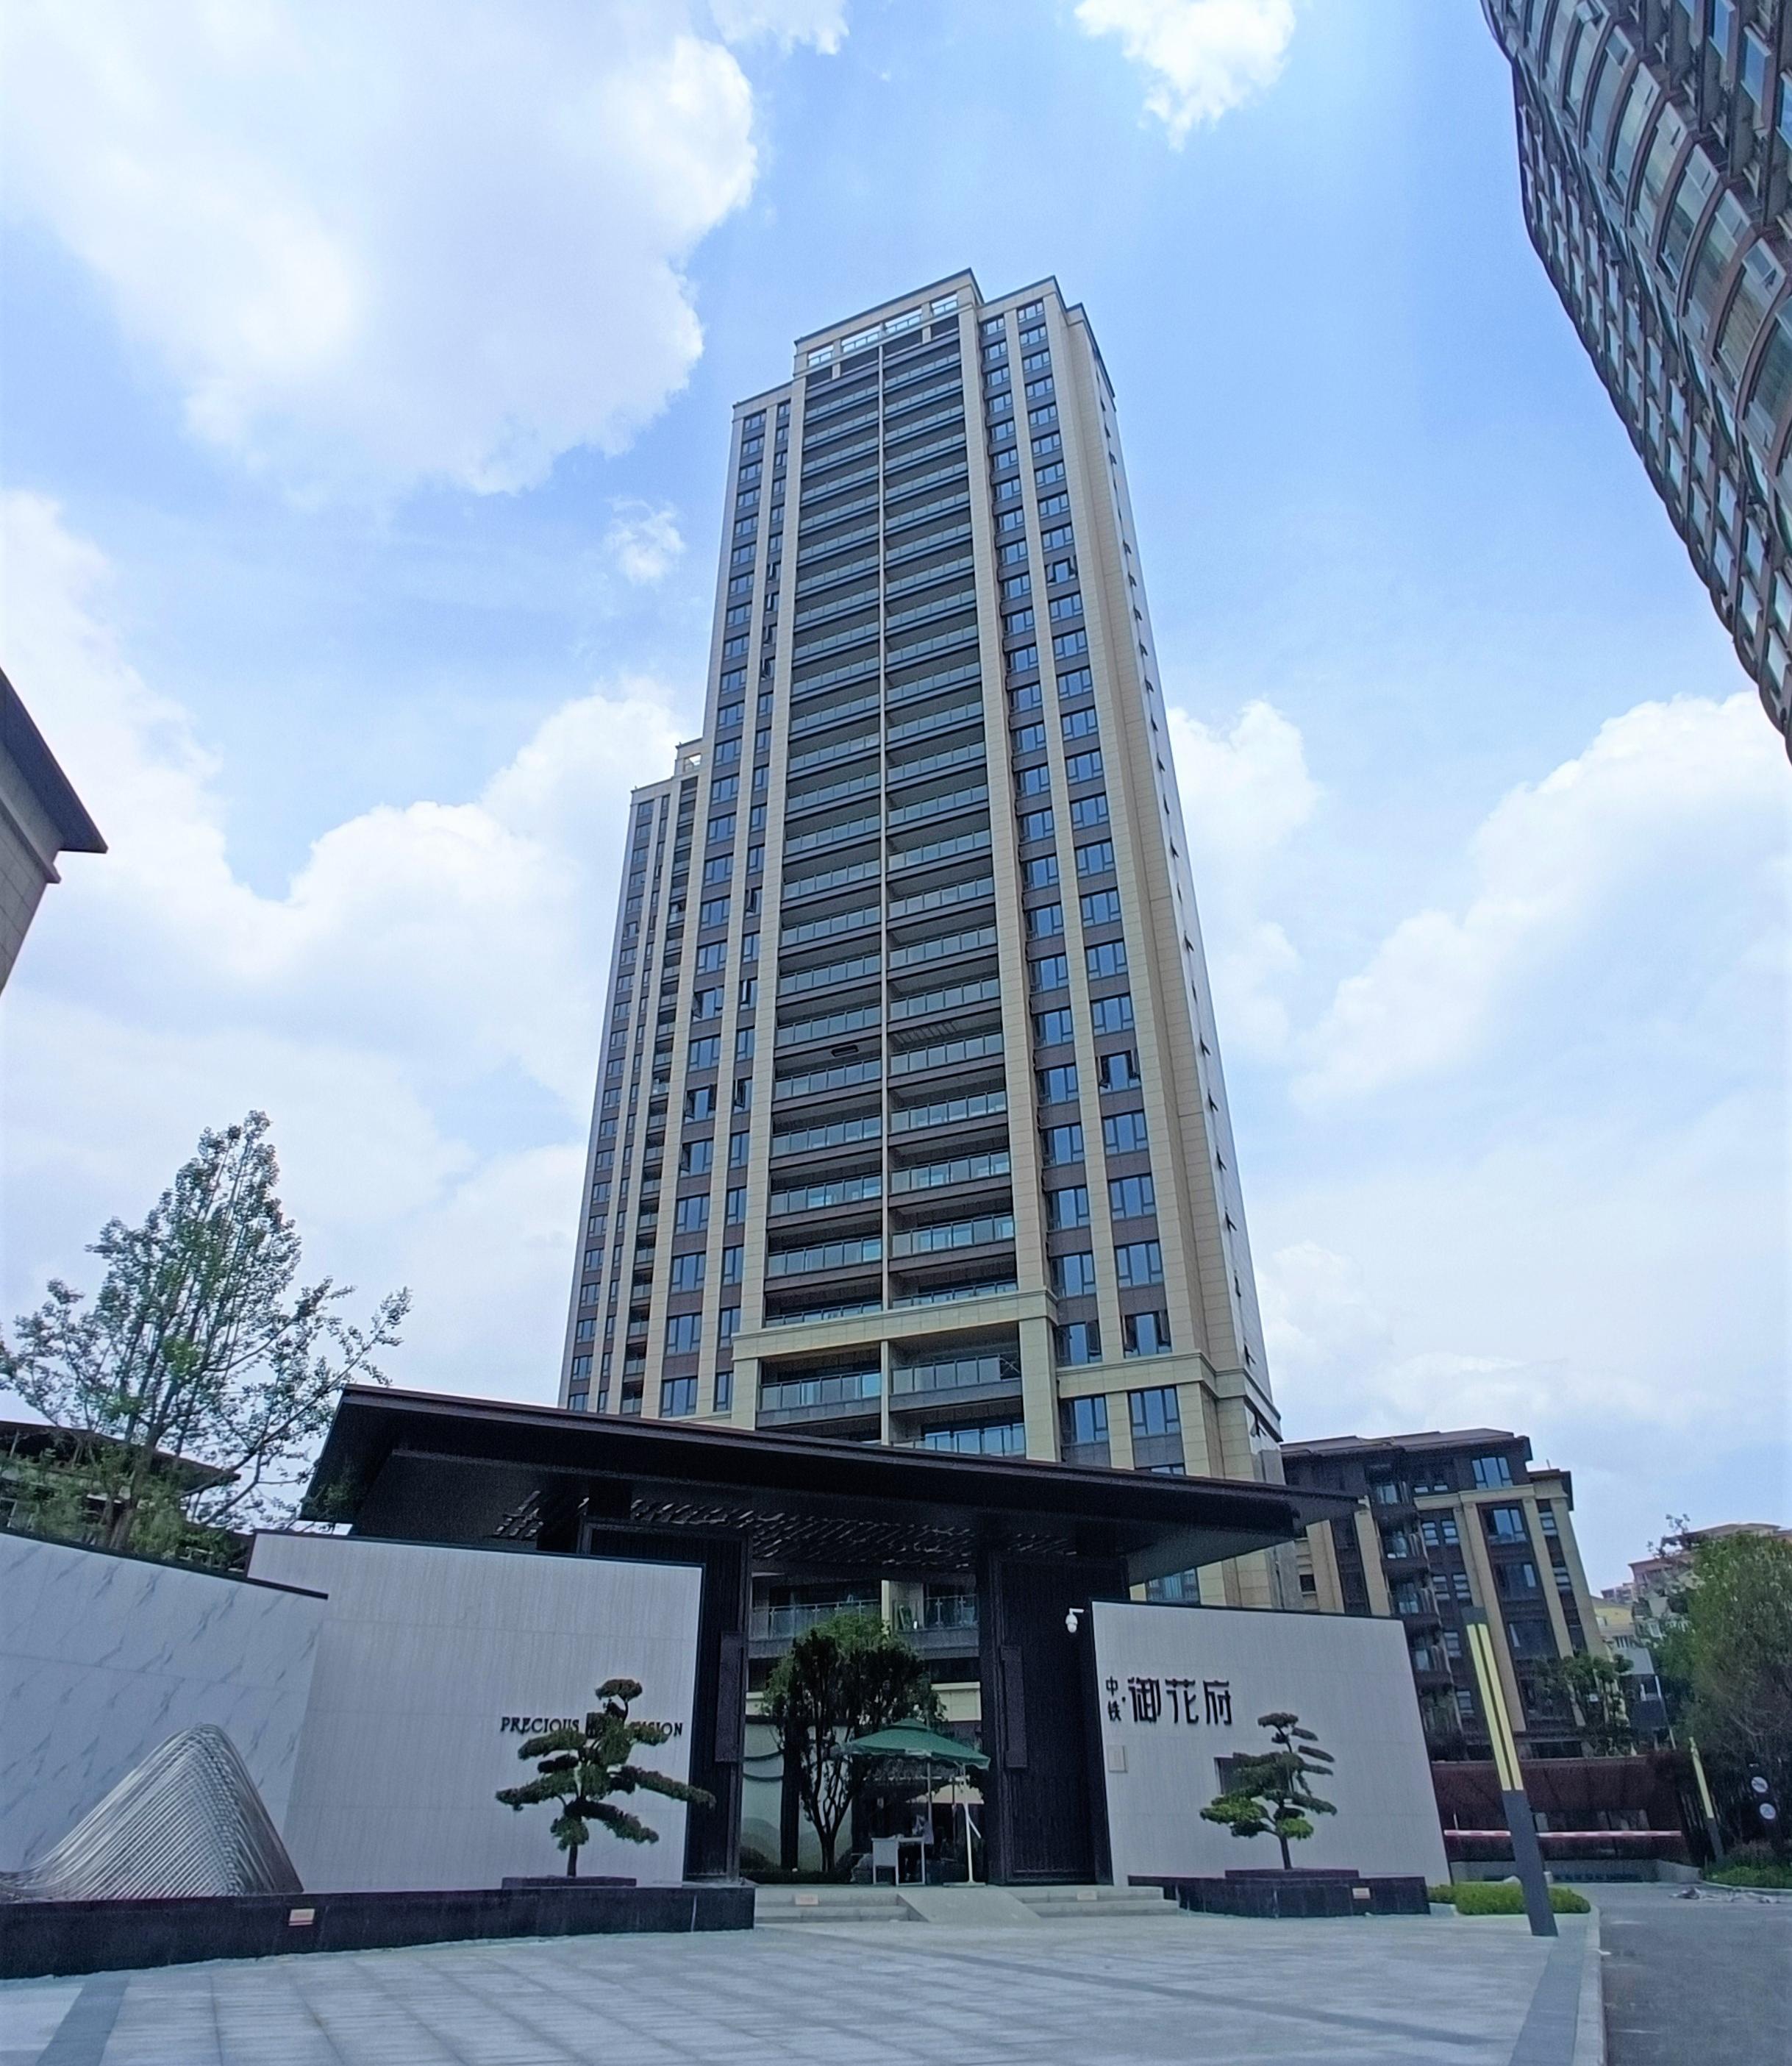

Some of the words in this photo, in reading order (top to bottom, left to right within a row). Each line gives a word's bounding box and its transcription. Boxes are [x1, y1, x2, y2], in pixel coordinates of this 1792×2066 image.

[1127, 1676, 1232, 1725] 御花府
[500, 1717, 579, 1734] PRECIOUS
